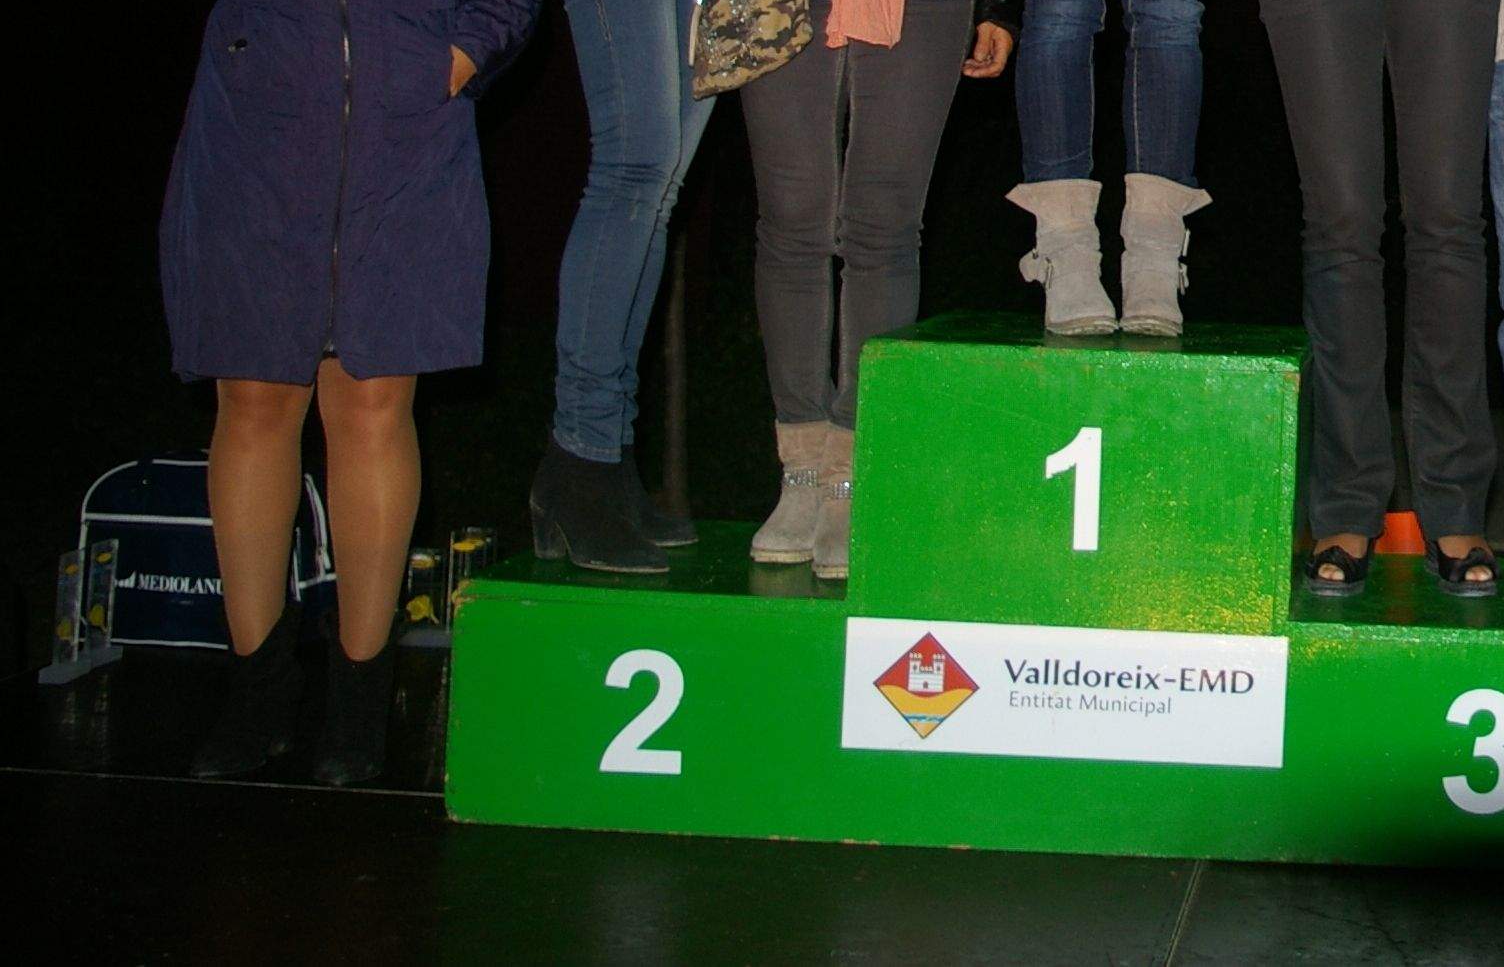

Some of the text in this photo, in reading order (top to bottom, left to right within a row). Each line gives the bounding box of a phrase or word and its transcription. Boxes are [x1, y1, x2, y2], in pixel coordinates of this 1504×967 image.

[1046, 426, 1102, 550] 1
[138, 573, 224, 595] MEDIOLANU
[1004, 658, 1255, 695] Valldoreix-EMD
[600, 649, 684, 775] 2
[1009, 690, 1172, 717] Entitat Municipal
